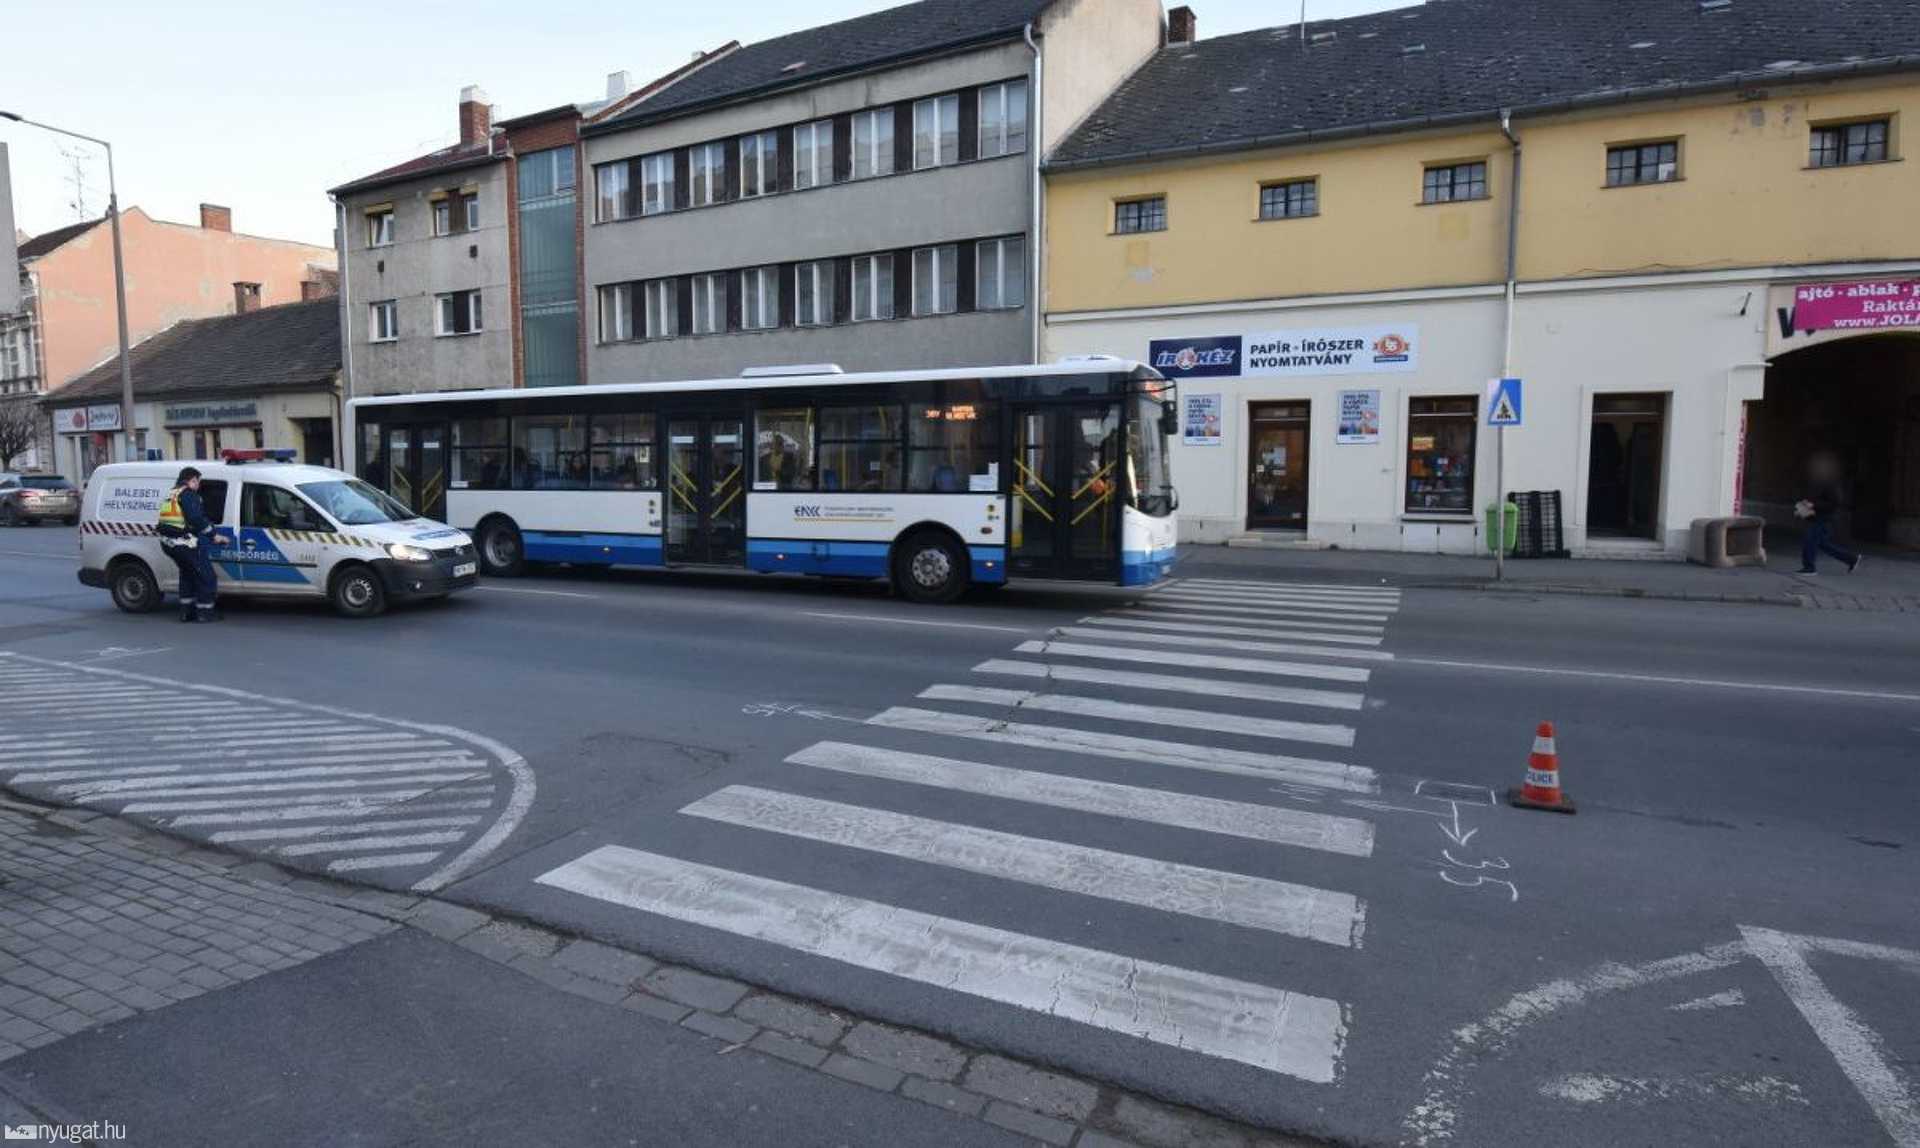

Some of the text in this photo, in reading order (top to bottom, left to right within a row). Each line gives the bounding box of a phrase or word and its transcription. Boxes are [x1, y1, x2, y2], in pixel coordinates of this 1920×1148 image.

[1847, 282, 1899, 297] ablak
[1250, 341, 1291, 355] PAPÍR
[1301, 338, 1364, 352] ÍRÓSZER
[1250, 351, 1352, 368] NYOMTATVÁNY
